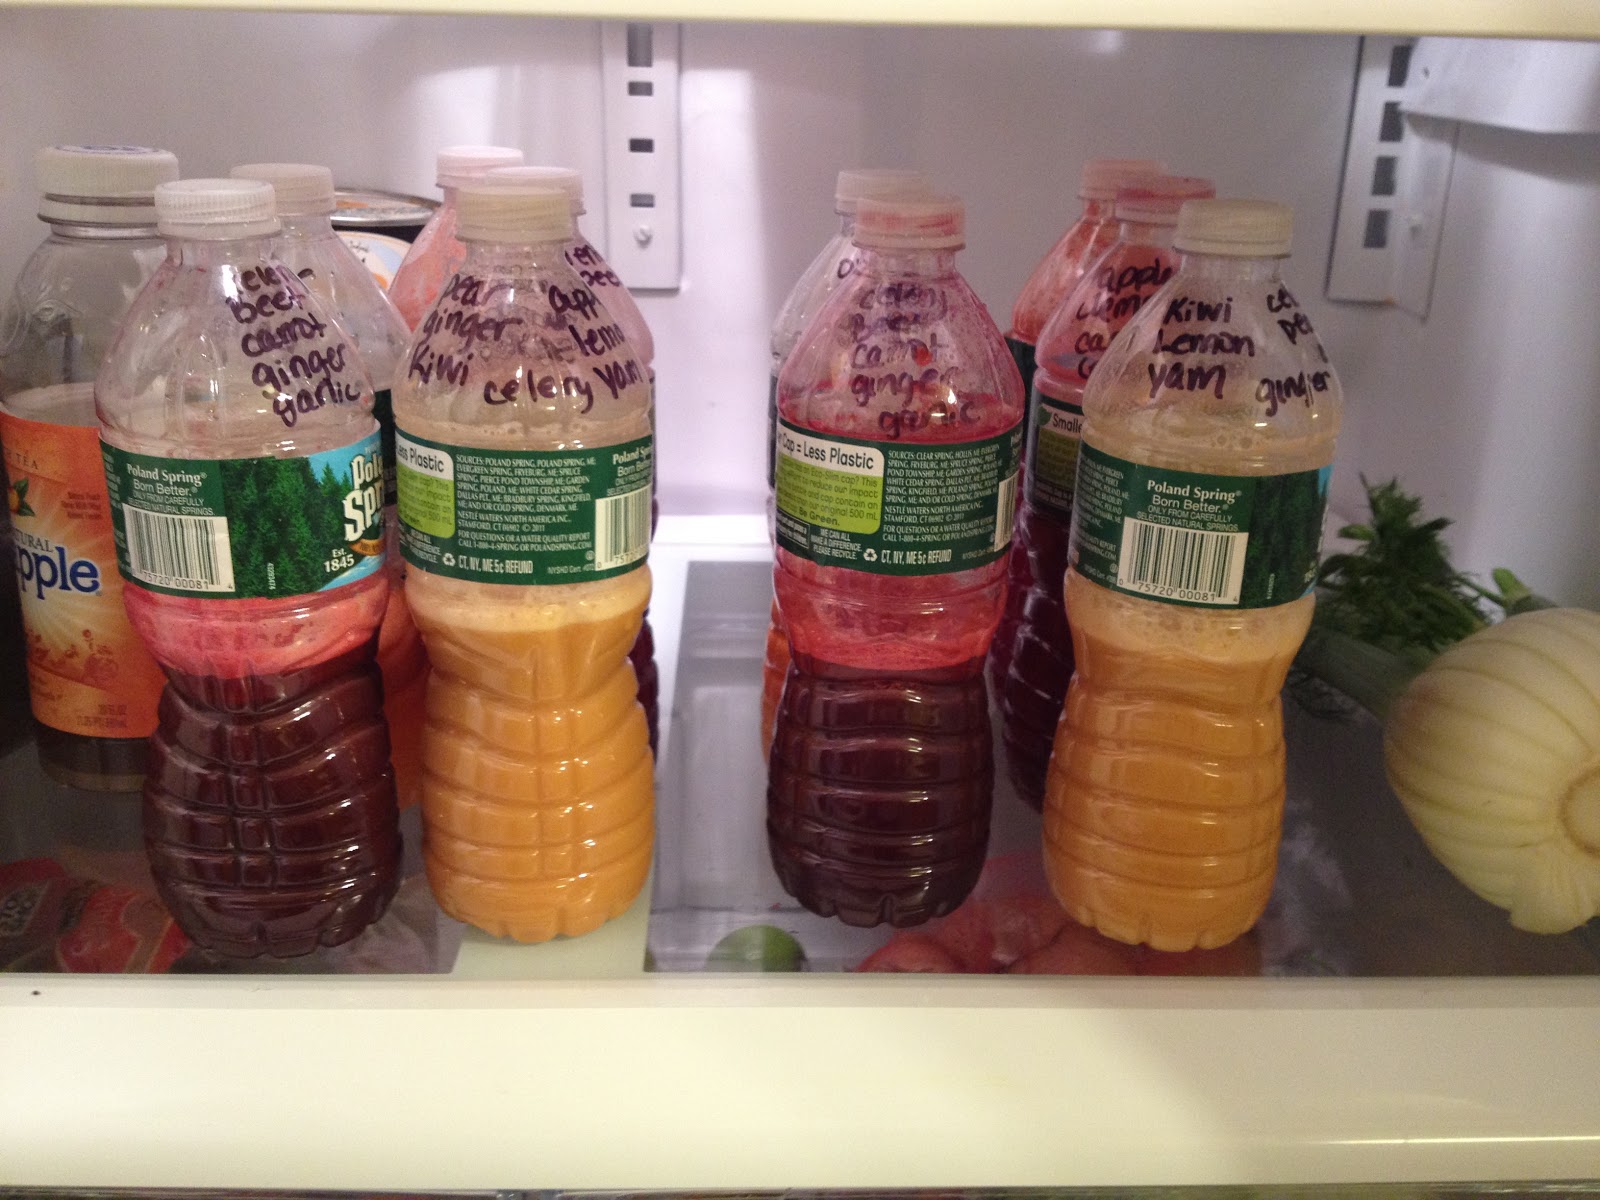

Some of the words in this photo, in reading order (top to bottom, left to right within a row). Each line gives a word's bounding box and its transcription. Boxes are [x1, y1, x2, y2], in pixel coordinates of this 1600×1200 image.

[422, 308, 523, 354] ginger
[252, 343, 346, 399] ginger
[484, 369, 594, 414] celery
[273, 378, 361, 427] garlic
[409, 447, 445, 473] Plastic
[612, 447, 640, 466] Poland
[803, 441, 826, 462] Less
[829, 447, 874, 470] Plastic
[126, 463, 159, 479] Poland
[133, 479, 154, 493] Born
[1147, 480, 1190, 496] Poland
[1152, 494, 1180, 508] Born
[1136, 511, 1171, 525] SELECTED
[1172, 519, 1204, 530] NATURAL
[1148, 505, 1167, 514] ONLY
[1168, 508, 1189, 518] FROM
[1190, 511, 1232, 523] CAREFULLY
[324, 553, 355, 572] 1845
[927, 549, 952, 564] REFUND
[505, 560, 533, 574] REFUND
[1138, 581, 1174, 597] 75720
[1179, 590, 1216, 602] 00081
